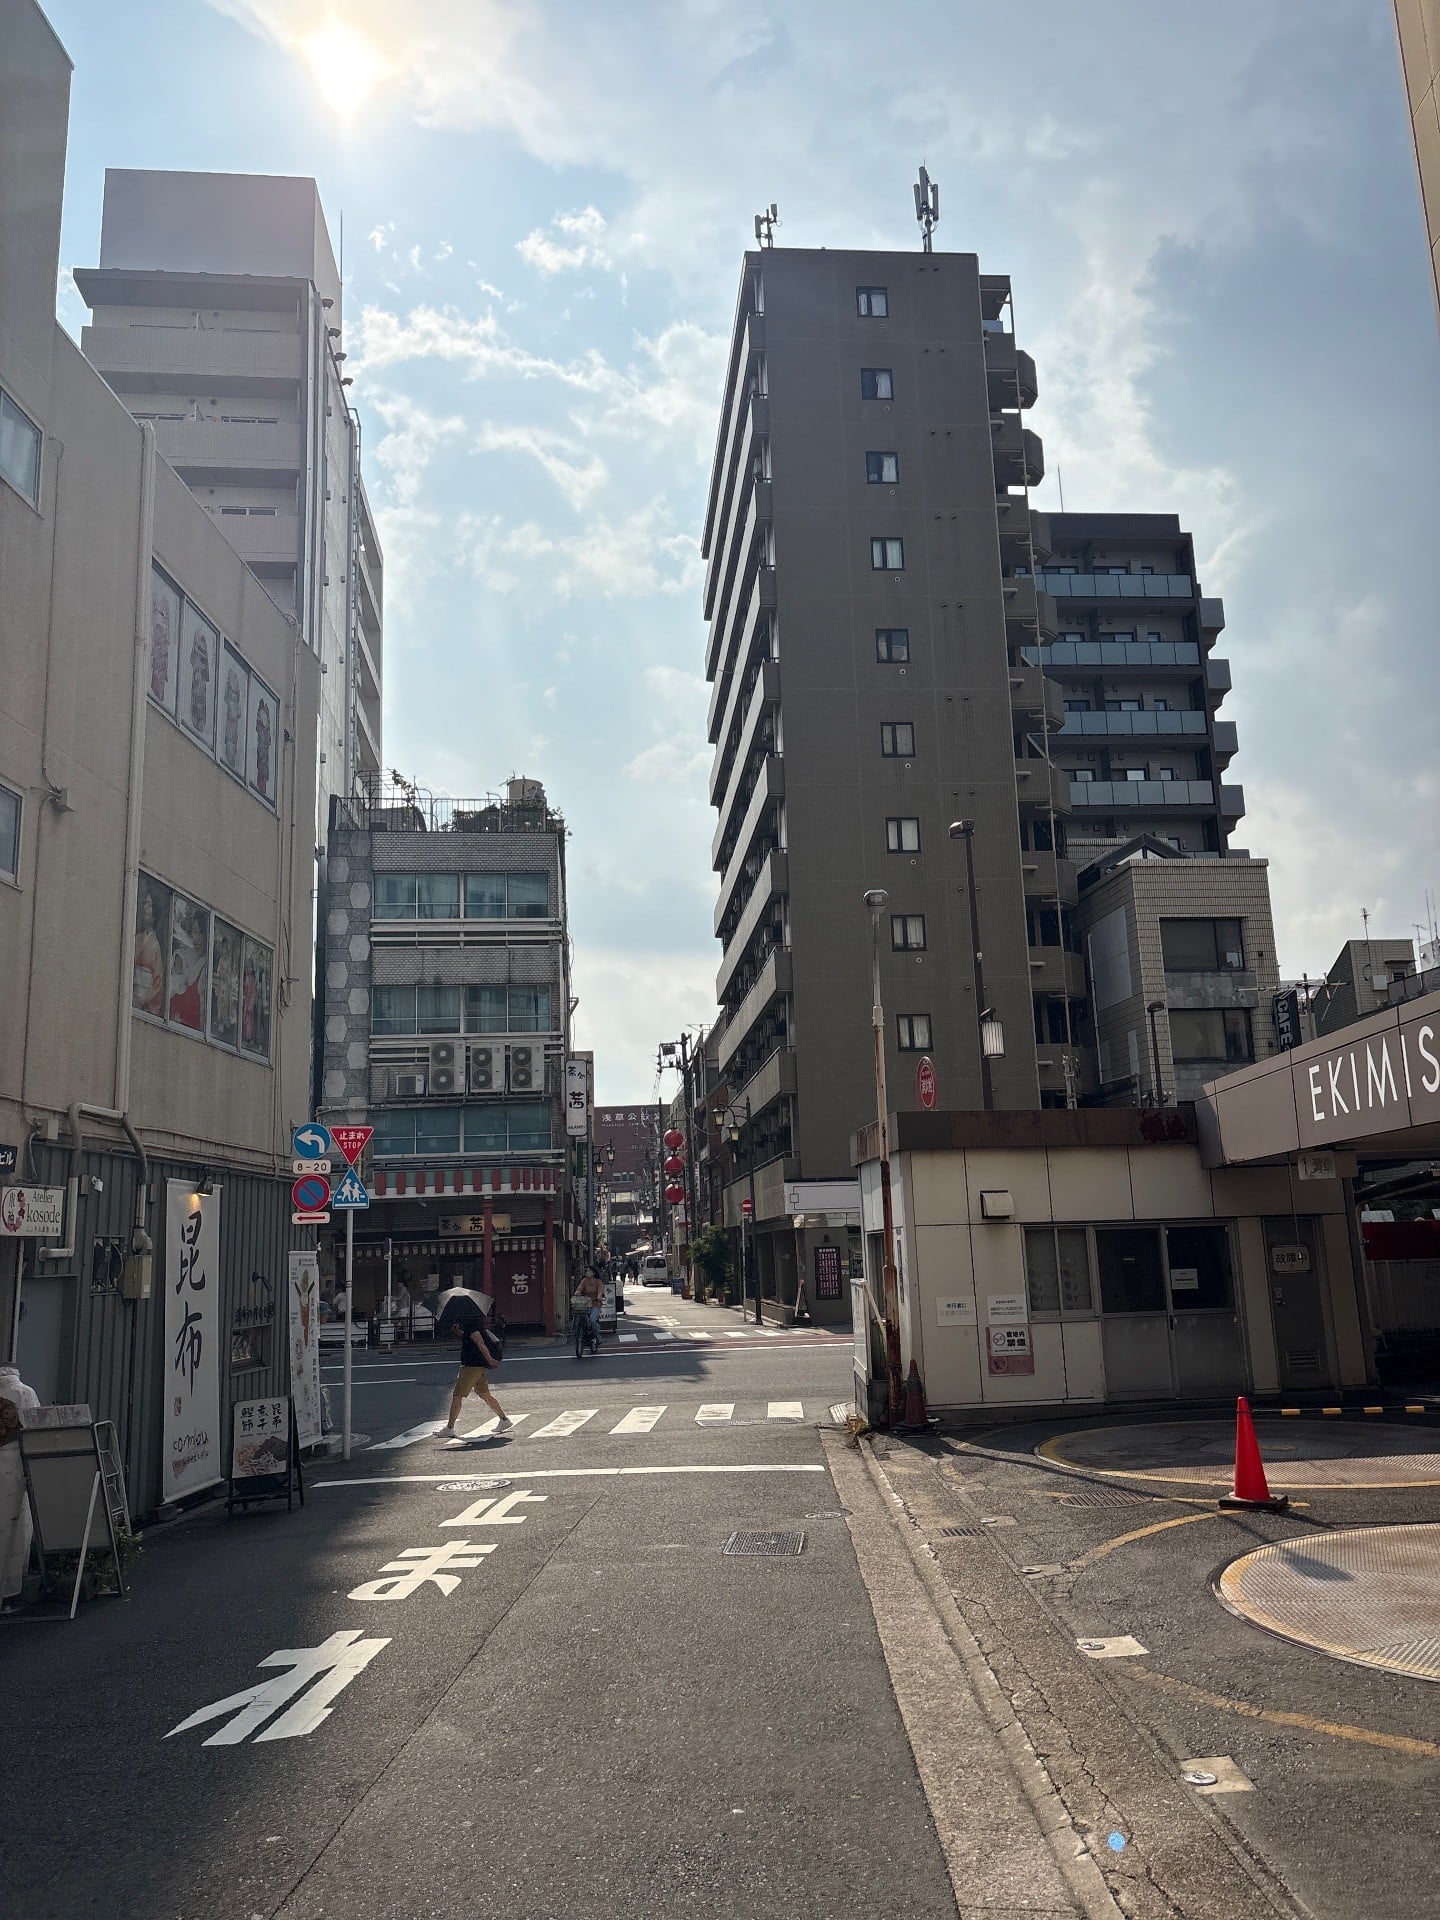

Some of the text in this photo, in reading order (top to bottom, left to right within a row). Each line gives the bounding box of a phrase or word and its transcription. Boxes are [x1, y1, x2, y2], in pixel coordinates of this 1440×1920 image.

[1277, 999, 1293, 1046] CAFE
[1308, 1025, 1440, 1121] EKIMIS
[339, 1130, 365, 1140] 止まれ
[343, 1141, 362, 1149] STOP
[31, 1190, 54, 1204] Atelier
[26, 1203, 61, 1224] kosode
[1275, 1251, 1307, 1264] 故障中
[174, 1210, 206, 1398] 昆布
[161, 1489, 549, 1747] 止まれ
